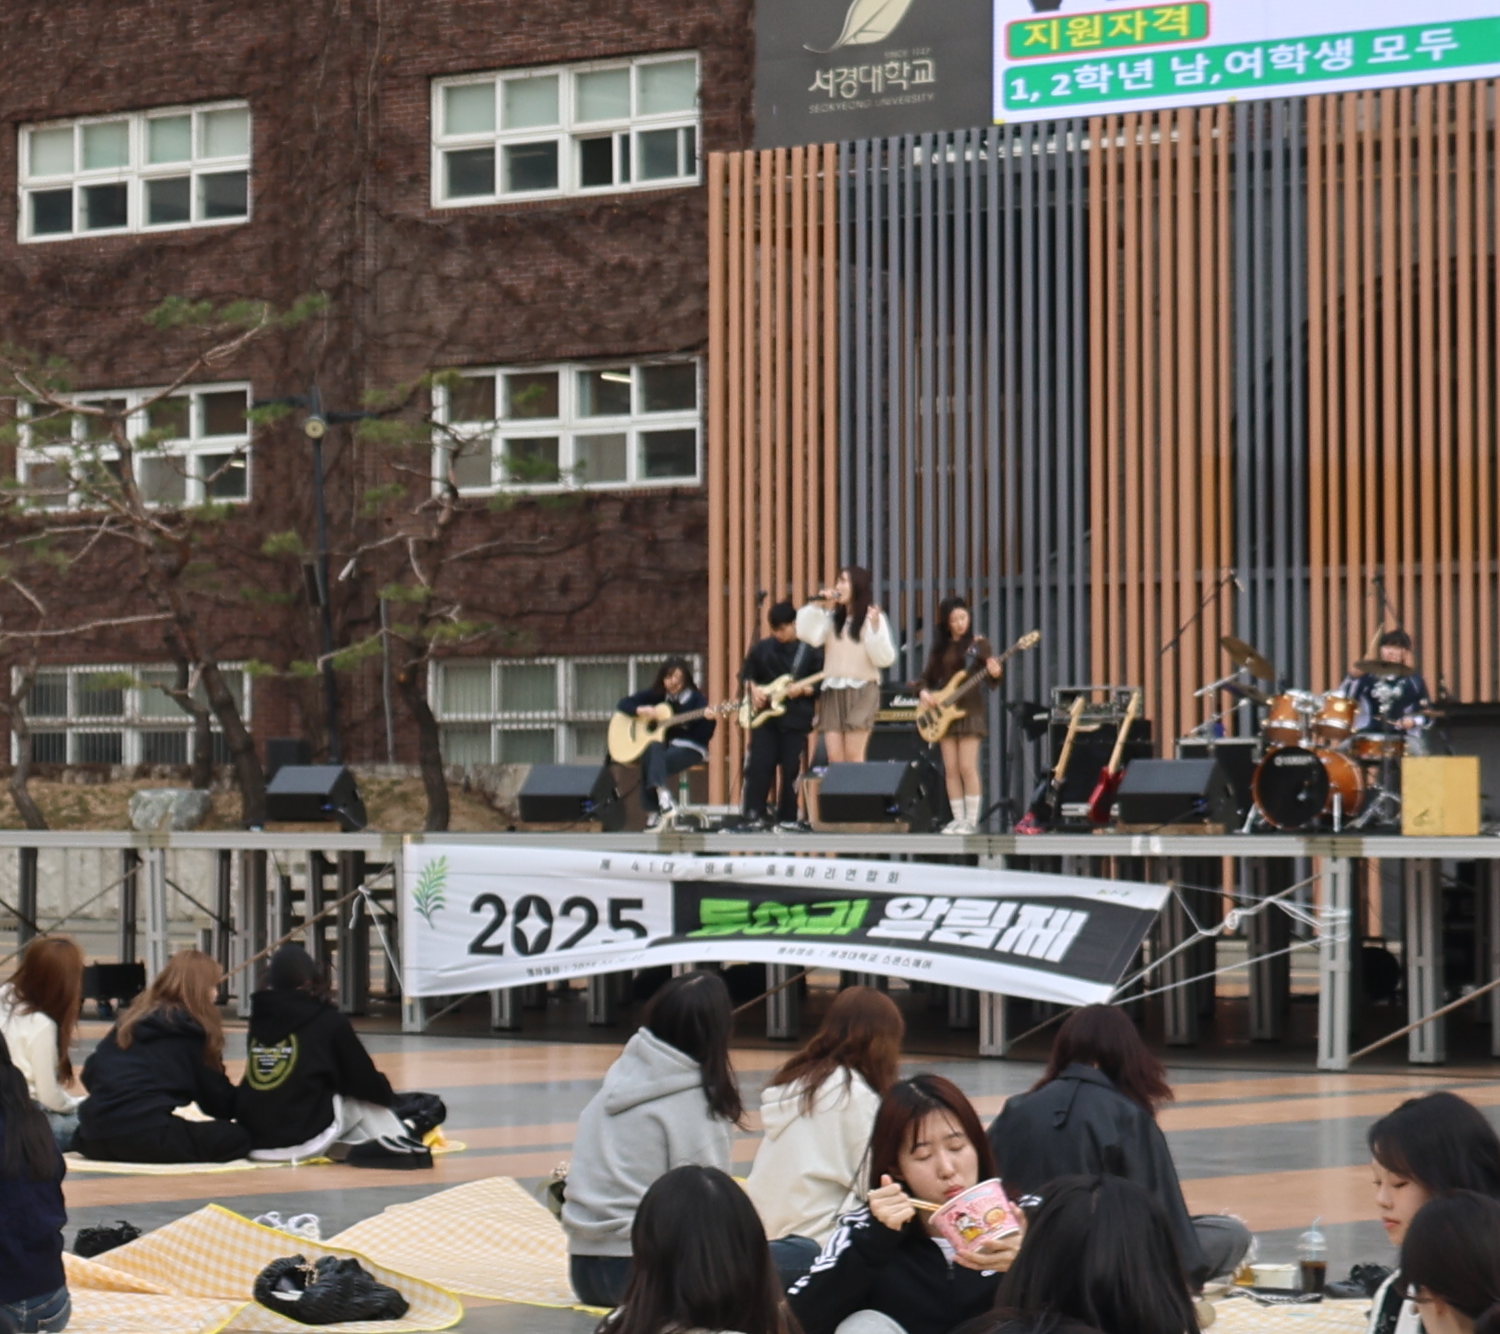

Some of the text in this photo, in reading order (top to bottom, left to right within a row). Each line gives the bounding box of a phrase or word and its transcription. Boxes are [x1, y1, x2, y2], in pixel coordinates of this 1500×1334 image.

[1023, 5, 1192, 50] 지원자격
[807, 59, 936, 99] 서경대학교
[1010, 27, 1460, 102] 1, 2학년 남,여학생 모두
[875, 93, 935, 107] UNIVERSITY
[467, 891, 648, 957] 2025
[866, 896, 1090, 963] 알림제
